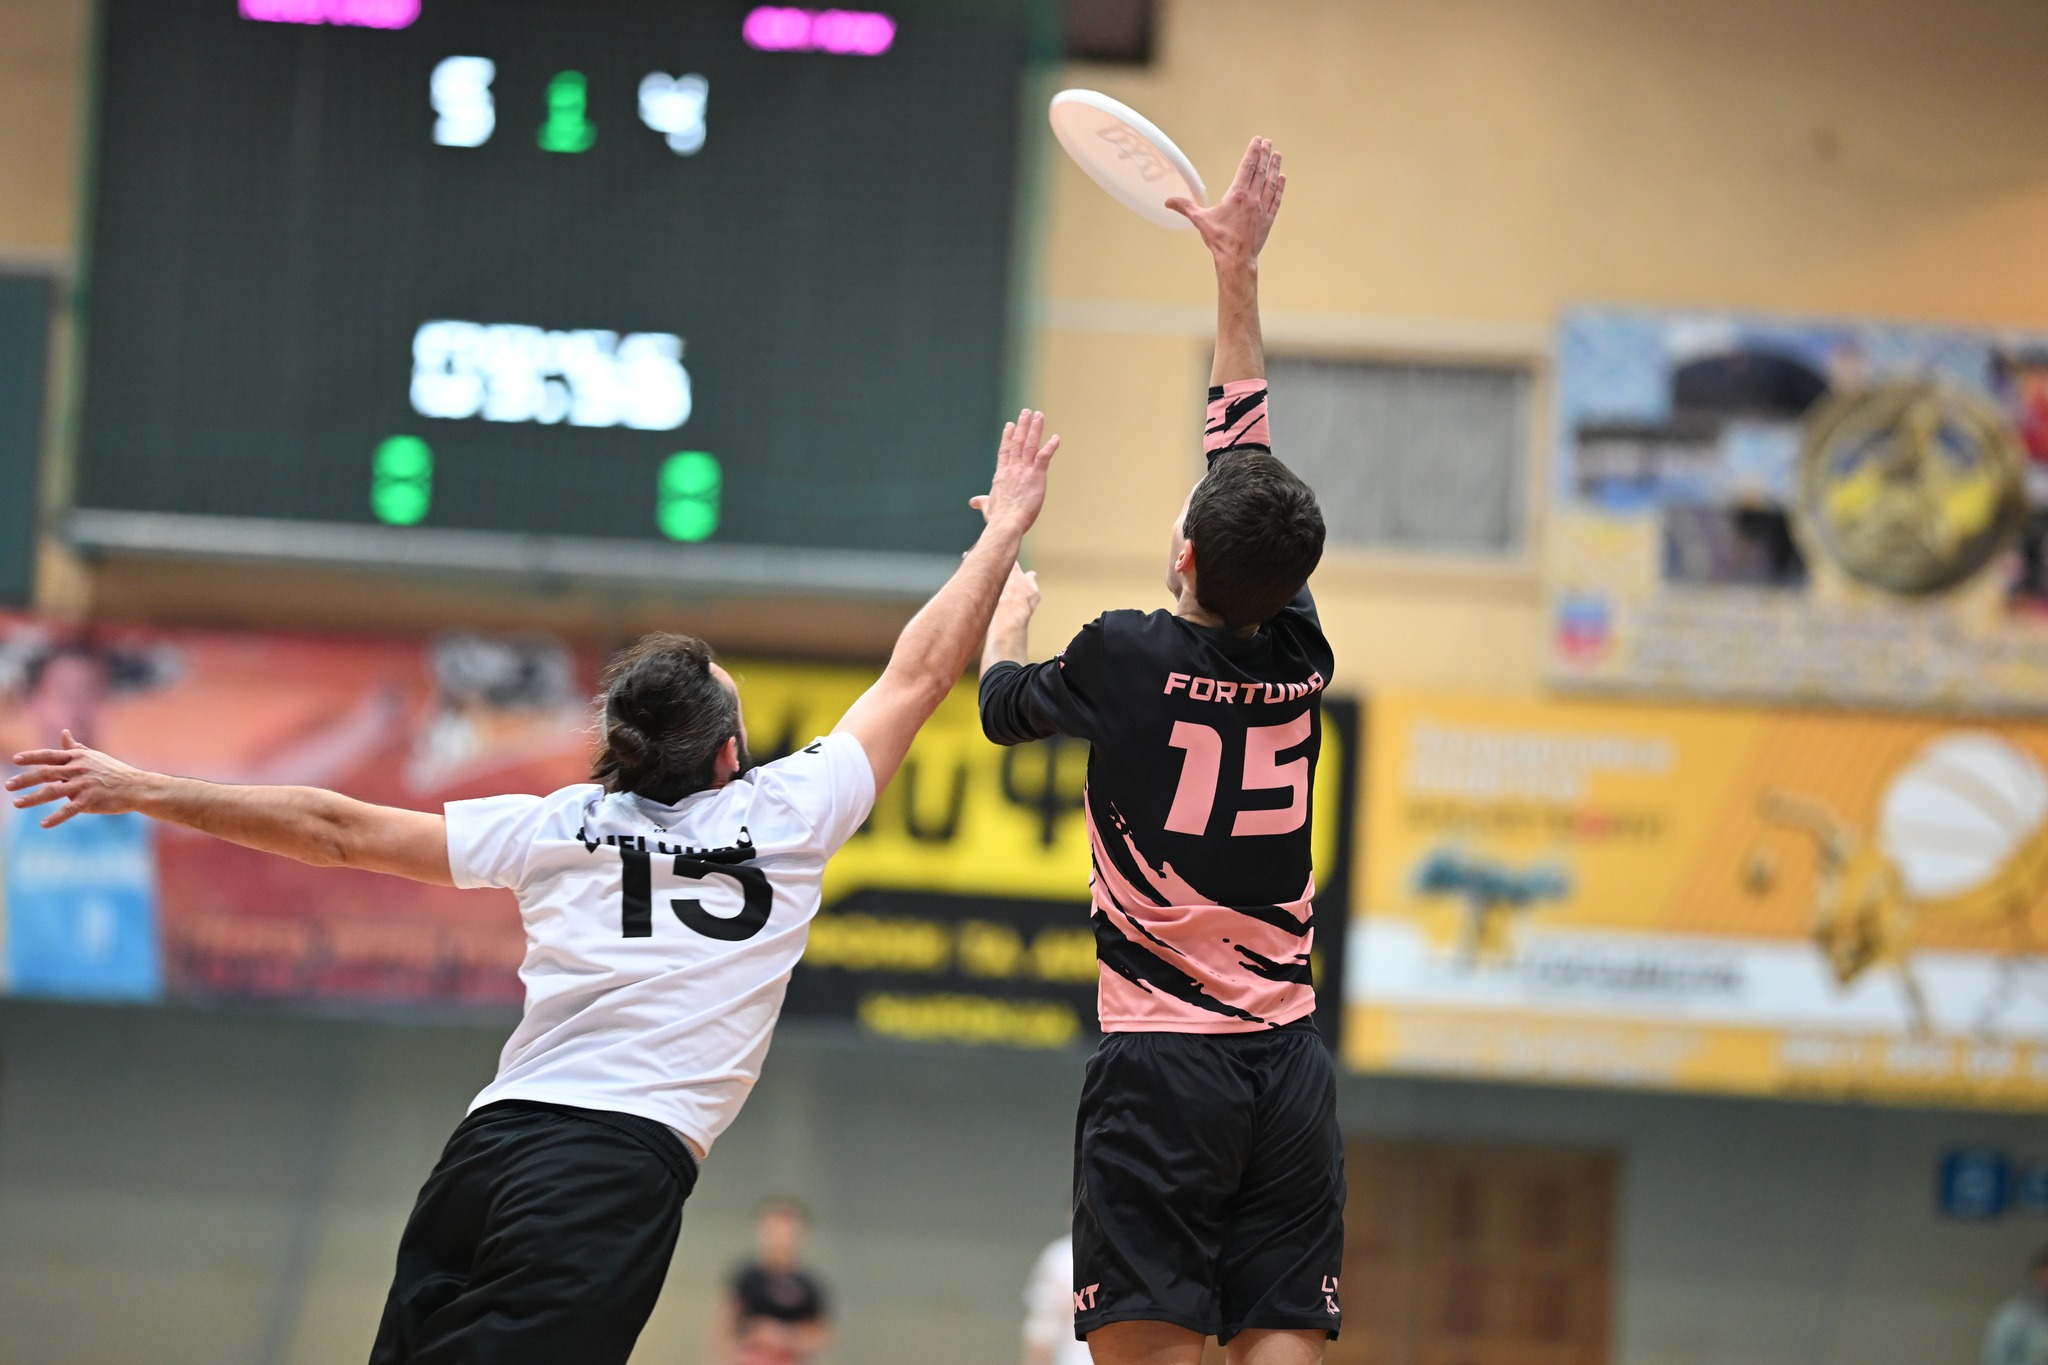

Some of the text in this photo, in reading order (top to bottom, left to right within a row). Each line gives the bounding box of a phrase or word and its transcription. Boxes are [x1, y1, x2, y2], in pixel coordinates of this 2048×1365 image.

[1163, 671, 1324, 704] FORTUNA
[1163, 708, 1312, 836] 15
[620, 846, 773, 941] 15
